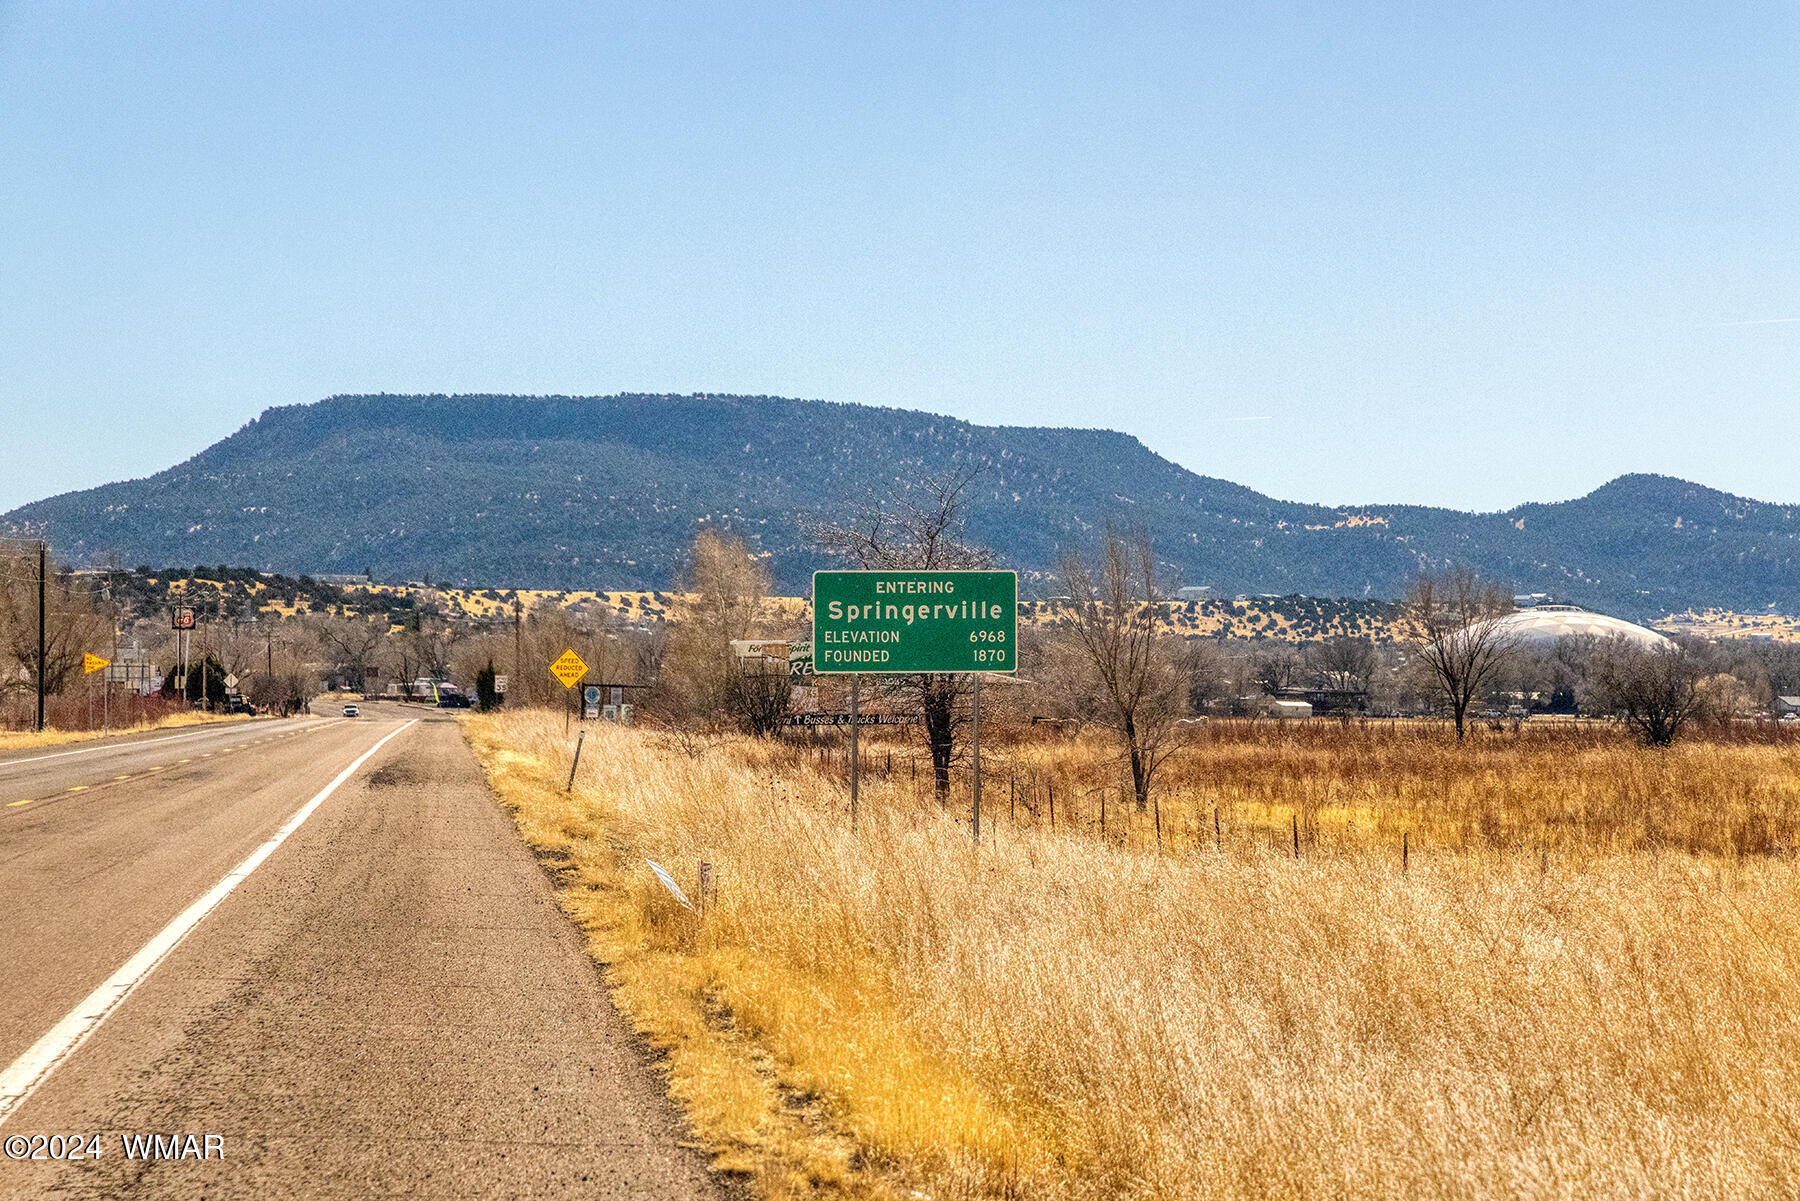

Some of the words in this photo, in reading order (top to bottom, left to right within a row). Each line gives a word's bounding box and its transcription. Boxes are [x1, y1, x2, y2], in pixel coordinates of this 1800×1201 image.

[876, 581, 954, 594] ENTERING
[828, 601, 1002, 625] Springerville
[824, 630, 900, 643] ELEVATION
[969, 630, 1006, 643] 6968
[787, 644, 811, 654] pirit
[824, 650, 890, 662] FOUNDED
[973, 649, 1006, 662] 1870
